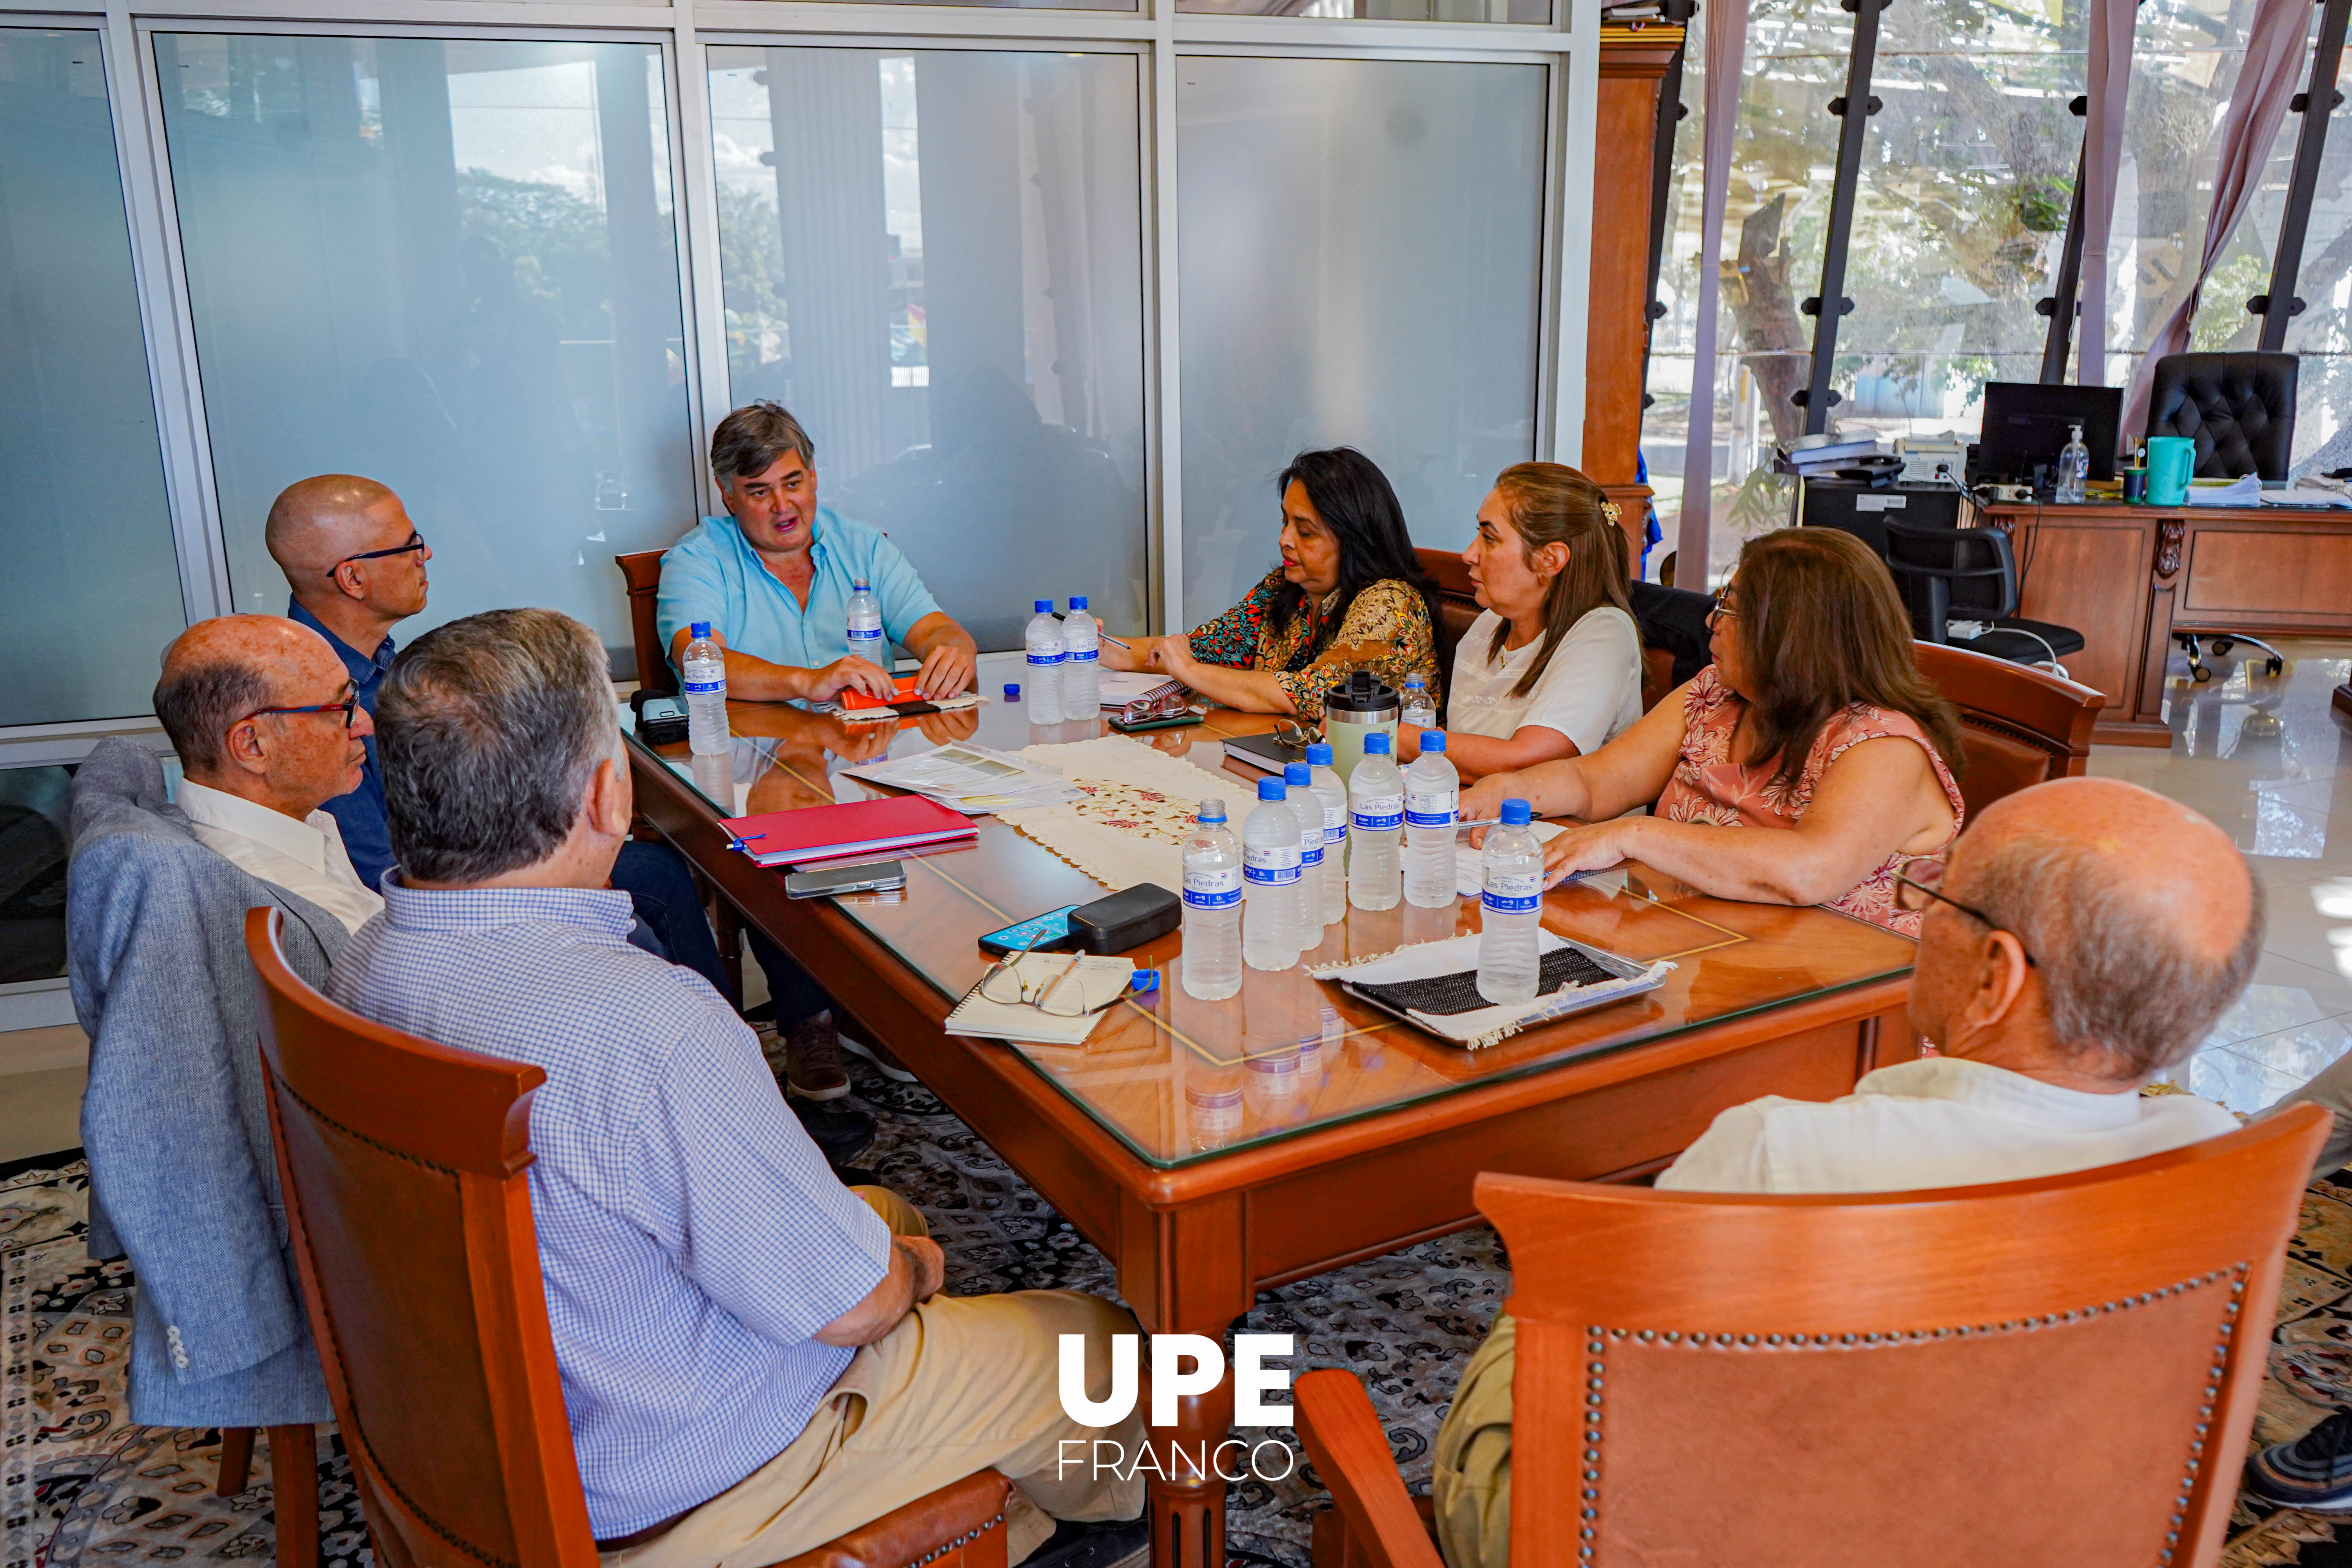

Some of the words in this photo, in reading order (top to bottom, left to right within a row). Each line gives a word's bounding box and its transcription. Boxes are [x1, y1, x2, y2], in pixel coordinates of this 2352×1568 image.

[1194, 878, 1224, 887] Piedras
[1487, 878, 1498, 889] Las
[1501, 882, 1532, 891] Piedras
